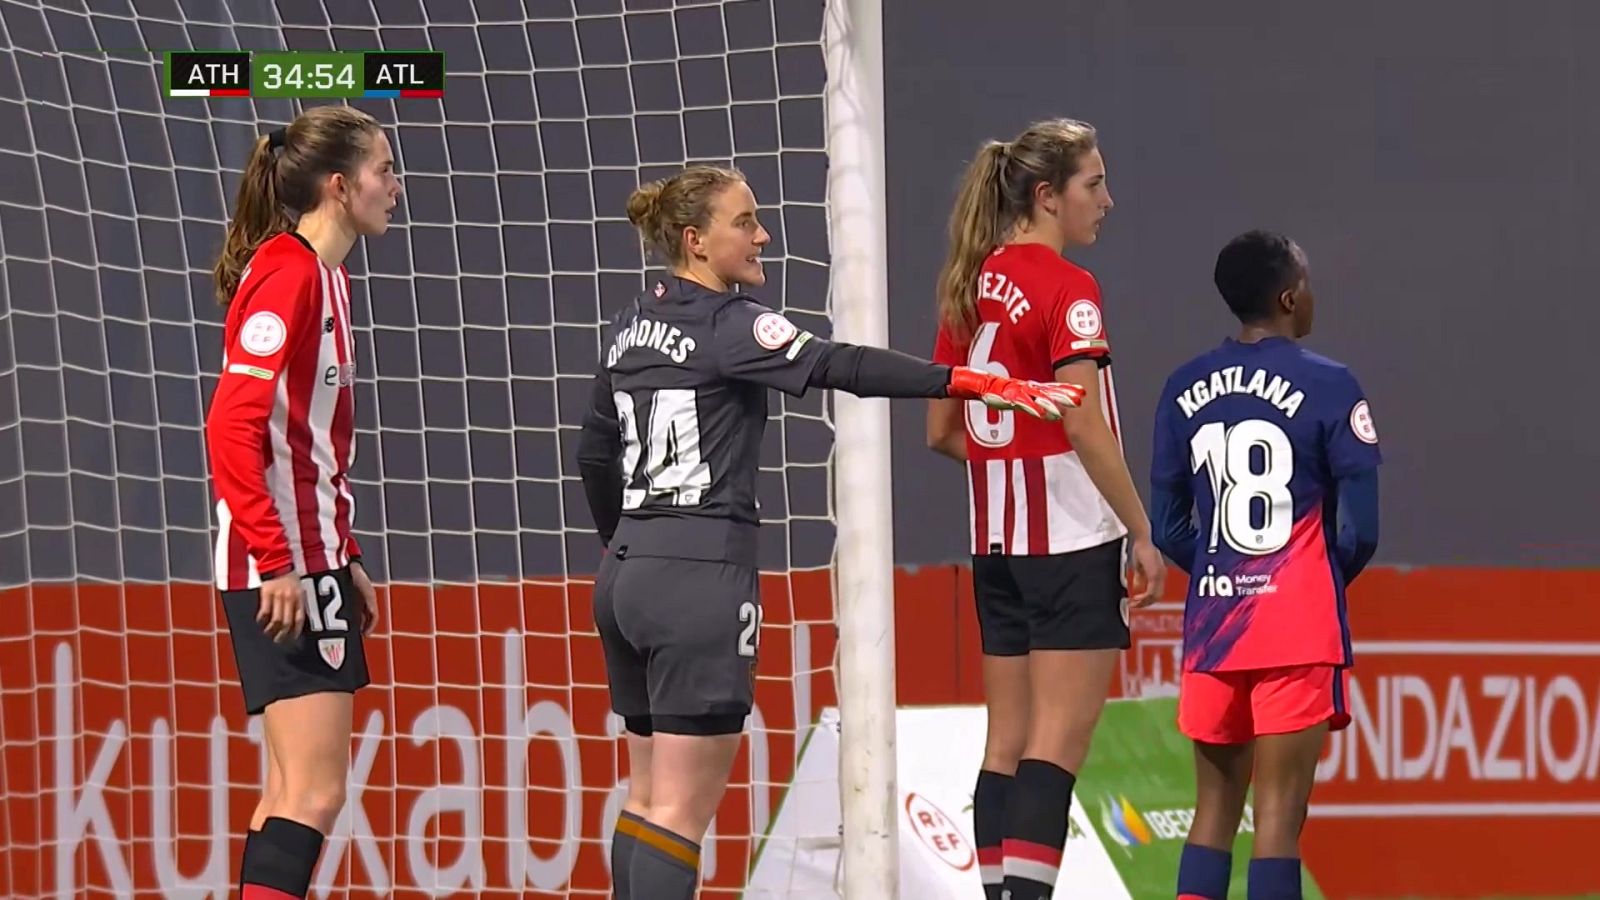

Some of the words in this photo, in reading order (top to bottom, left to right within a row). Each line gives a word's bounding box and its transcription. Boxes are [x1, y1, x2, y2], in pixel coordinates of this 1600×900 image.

[964, 321, 1016, 449] 6
[1176, 365, 1306, 420] KGATLANA
[613, 388, 714, 511] 24
[1189, 418, 1294, 557] 18
[301, 574, 348, 633] 12
[1198, 564, 1234, 597] ria
[1235, 574, 1272, 585] Money
[738, 602, 764, 657] 2
